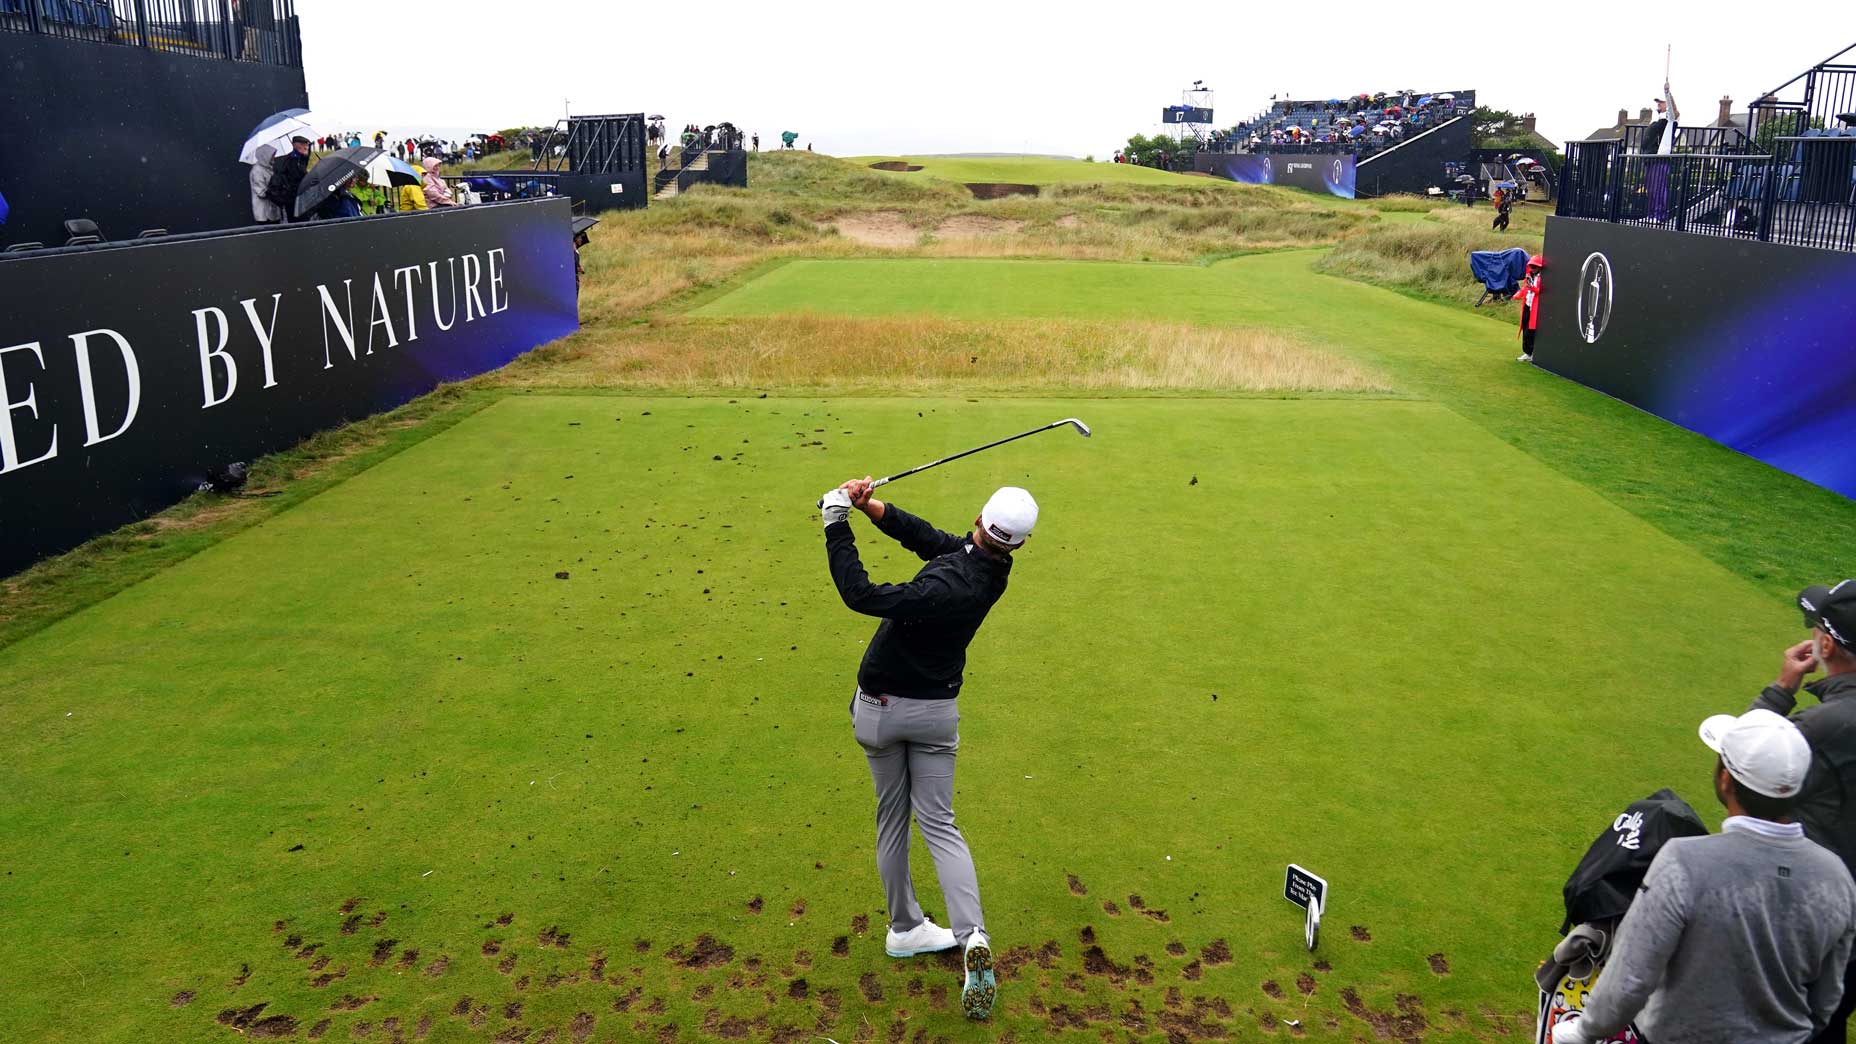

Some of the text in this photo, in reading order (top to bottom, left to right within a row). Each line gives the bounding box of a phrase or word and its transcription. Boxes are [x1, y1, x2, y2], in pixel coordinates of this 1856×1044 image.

[1176, 111, 1184, 121] 17
[0, 248, 508, 474] ED BY NATURE
[1292, 873, 1317, 892] Please Play
[1292, 881, 1305, 893] From
